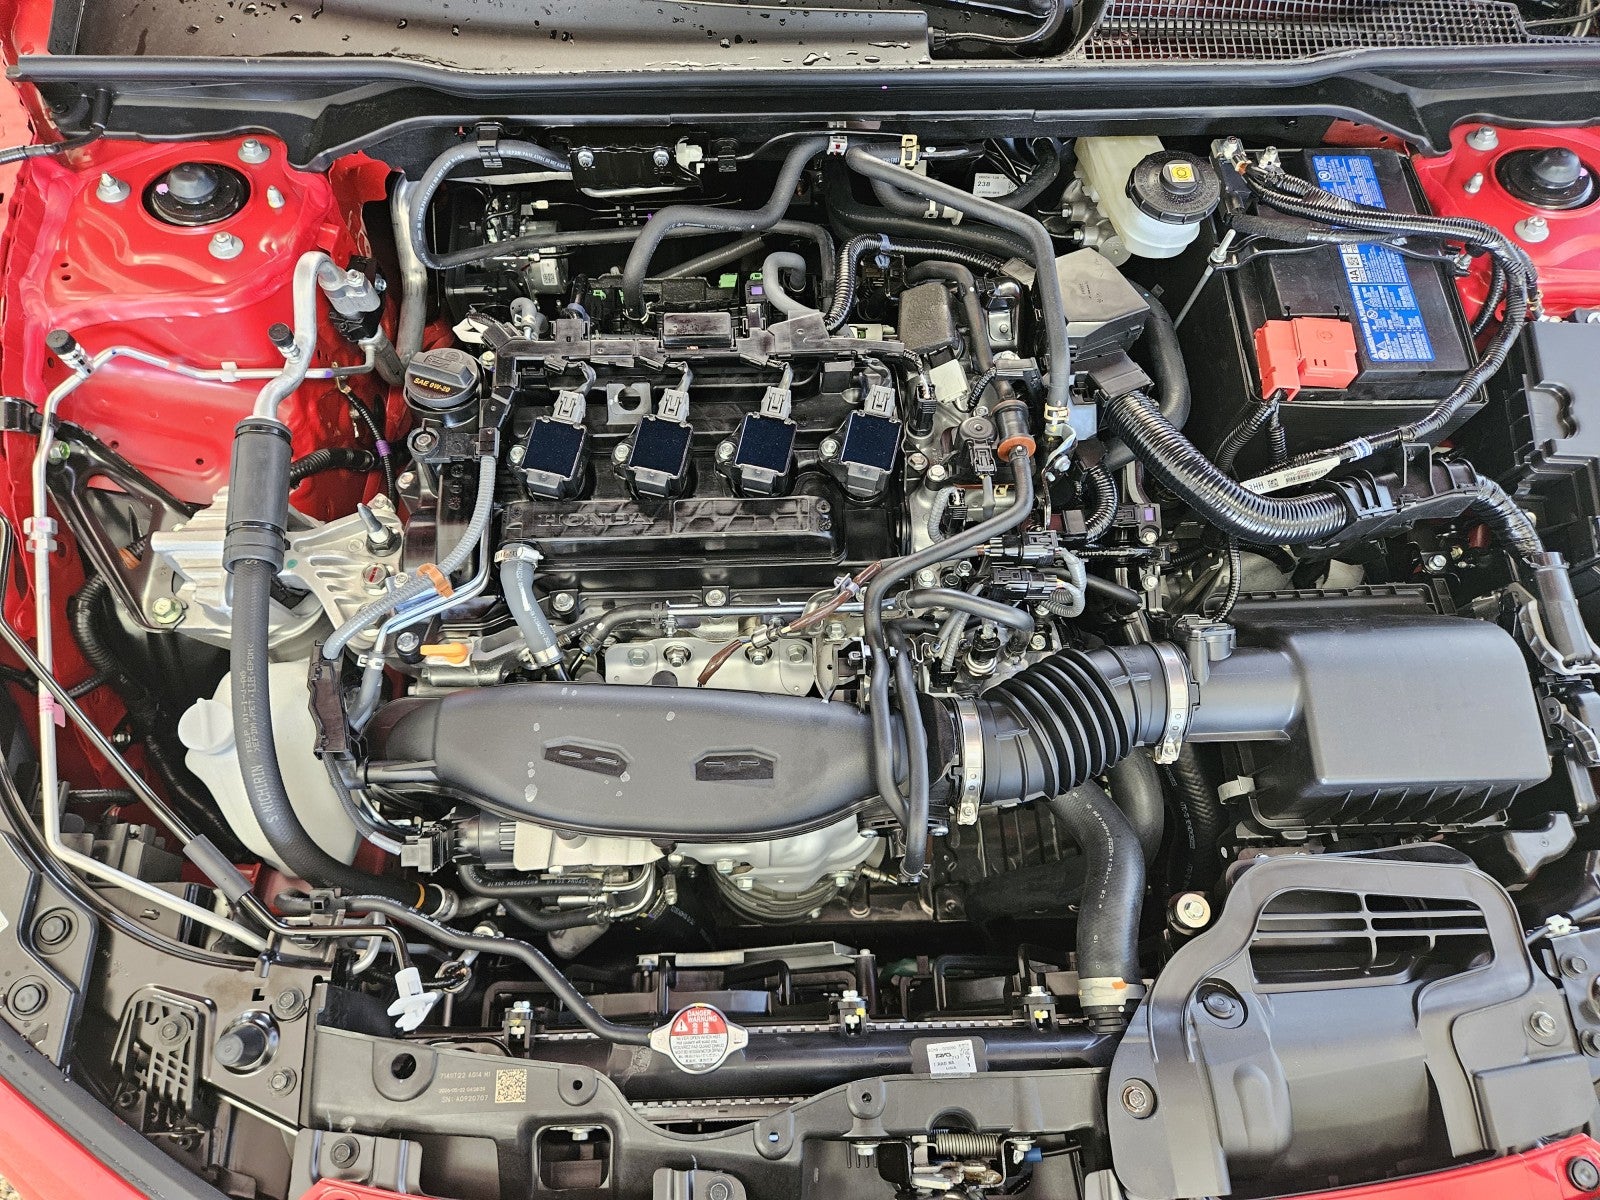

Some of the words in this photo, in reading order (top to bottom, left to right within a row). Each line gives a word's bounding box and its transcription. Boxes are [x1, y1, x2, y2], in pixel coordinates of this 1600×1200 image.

[413, 377, 428, 387] SAE
[429, 382, 451, 393] 0W-20
[537, 512, 655, 527] HONDA
[250, 764, 276, 813] NICHIRIN
